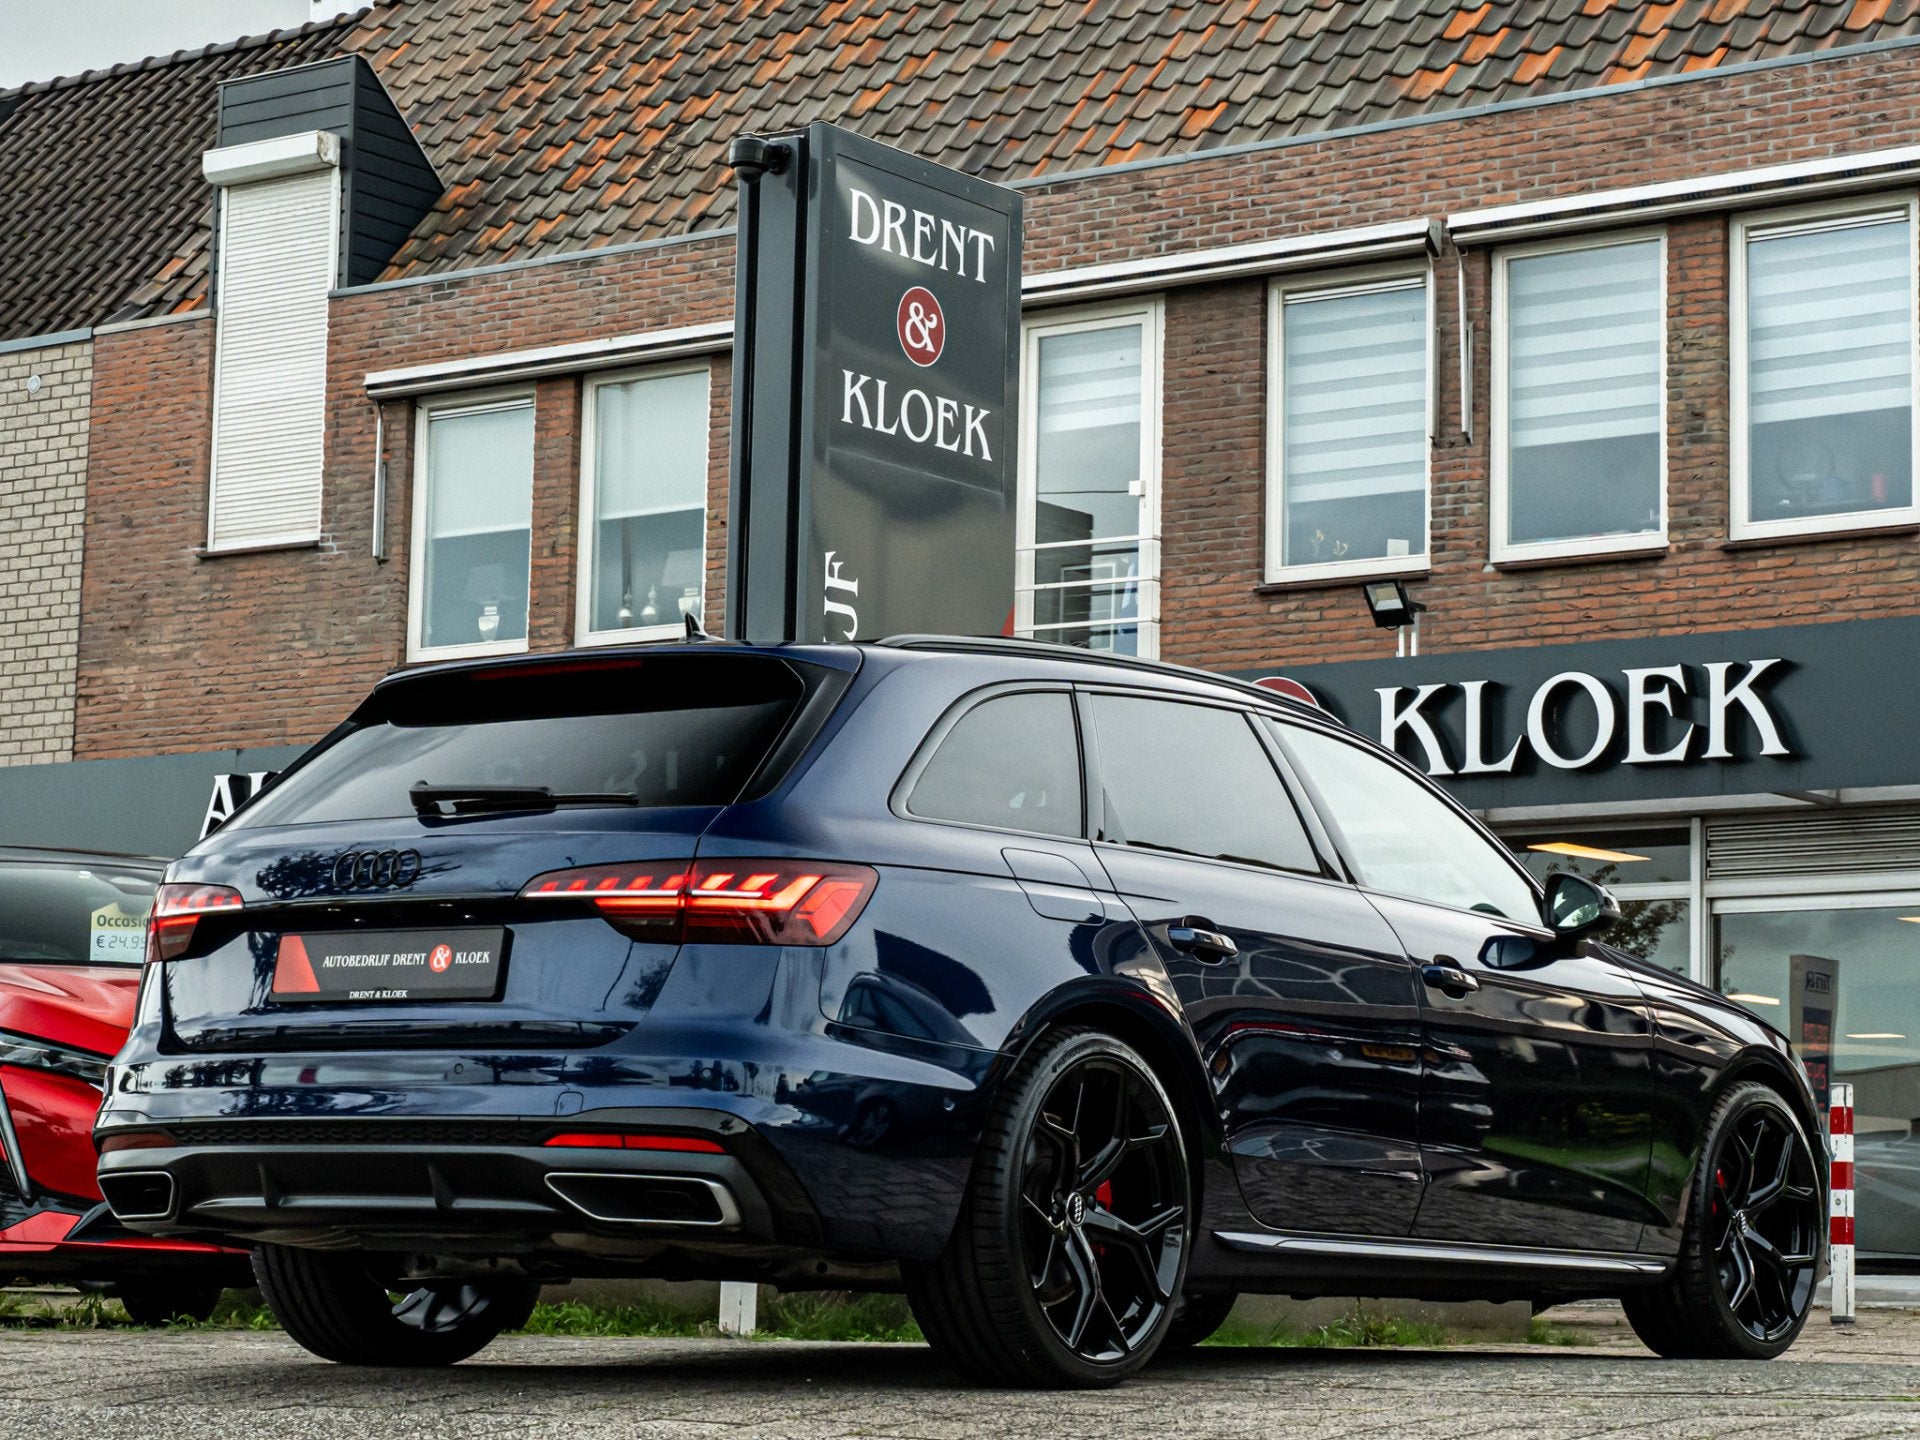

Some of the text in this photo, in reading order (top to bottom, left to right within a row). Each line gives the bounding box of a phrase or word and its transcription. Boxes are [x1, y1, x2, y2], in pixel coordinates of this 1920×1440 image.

[849, 188, 995, 284] DRENT
[905, 302, 937, 353] &
[841, 369, 993, 462] KLOEK
[822, 551, 859, 643] JF
[1374, 658, 1790, 777] KLOEK
[322, 948, 490, 968] AUTOBEDRIJF DRENT & KLOEK
[349, 990, 374, 999] DRENT
[381, 989, 407, 998] KLOEK
